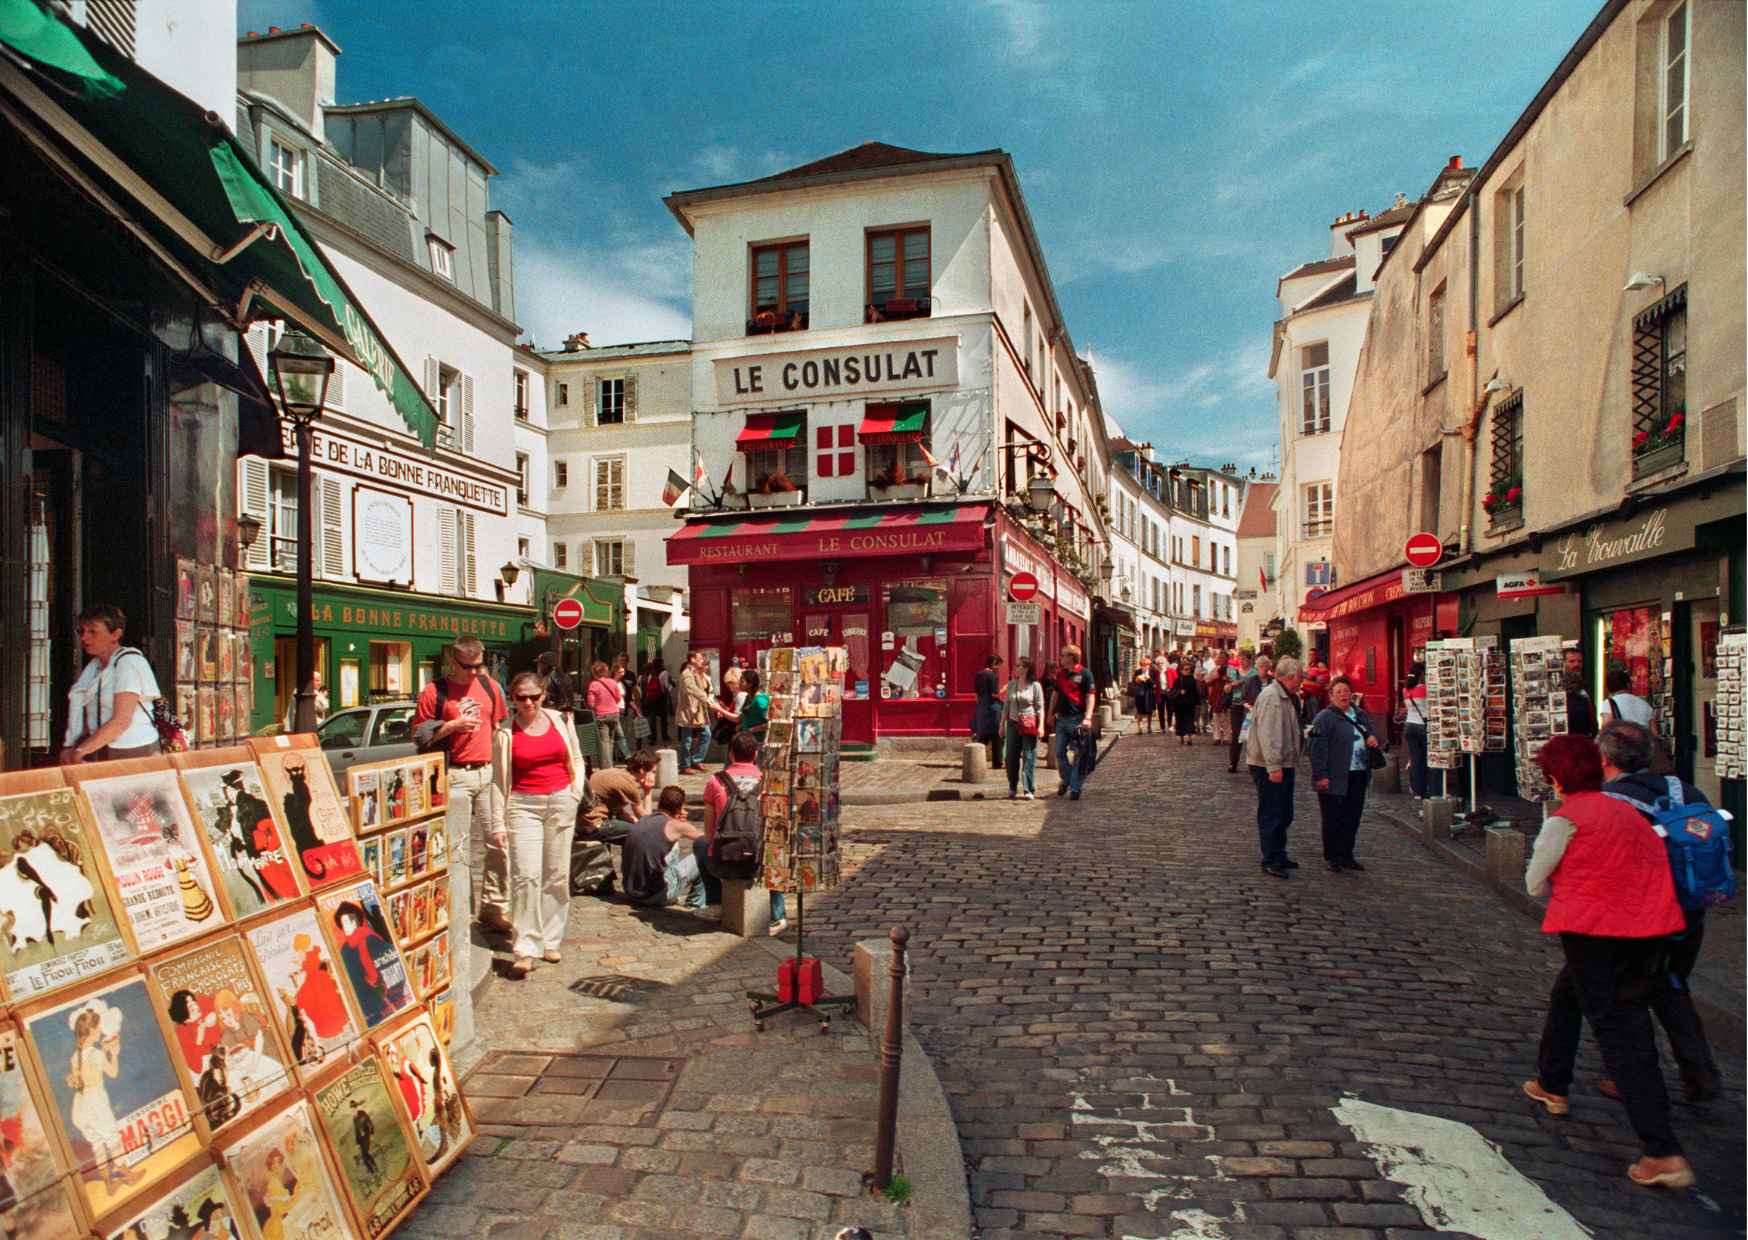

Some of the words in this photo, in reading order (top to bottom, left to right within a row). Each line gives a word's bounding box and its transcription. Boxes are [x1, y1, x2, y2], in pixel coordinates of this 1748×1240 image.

[734, 366, 763, 394] LE
[782, 349, 938, 391] CONSULAT
[328, 441, 350, 465] DE
[354, 448, 374, 471] LA
[378, 456, 424, 486] BONNE
[427, 470, 503, 508] FRANQUETTE
[700, 543, 777, 559] RESTAURANT
[817, 538, 840, 552] LE
[850, 531, 946, 551] CONSULAT
[1558, 532, 1577, 571] La
[1585, 508, 1668, 564] Trouvaille
[818, 585, 855, 603] CAFÉ
[1503, 580, 1525, 588] AGFA
[311, 602, 332, 622] LA
[342, 606, 401, 628] BONNE
[408, 613, 507, 636] FRANQUETTE
[29, 975, 45, 991] LE
[119, 1099, 185, 1152] MAGGI
